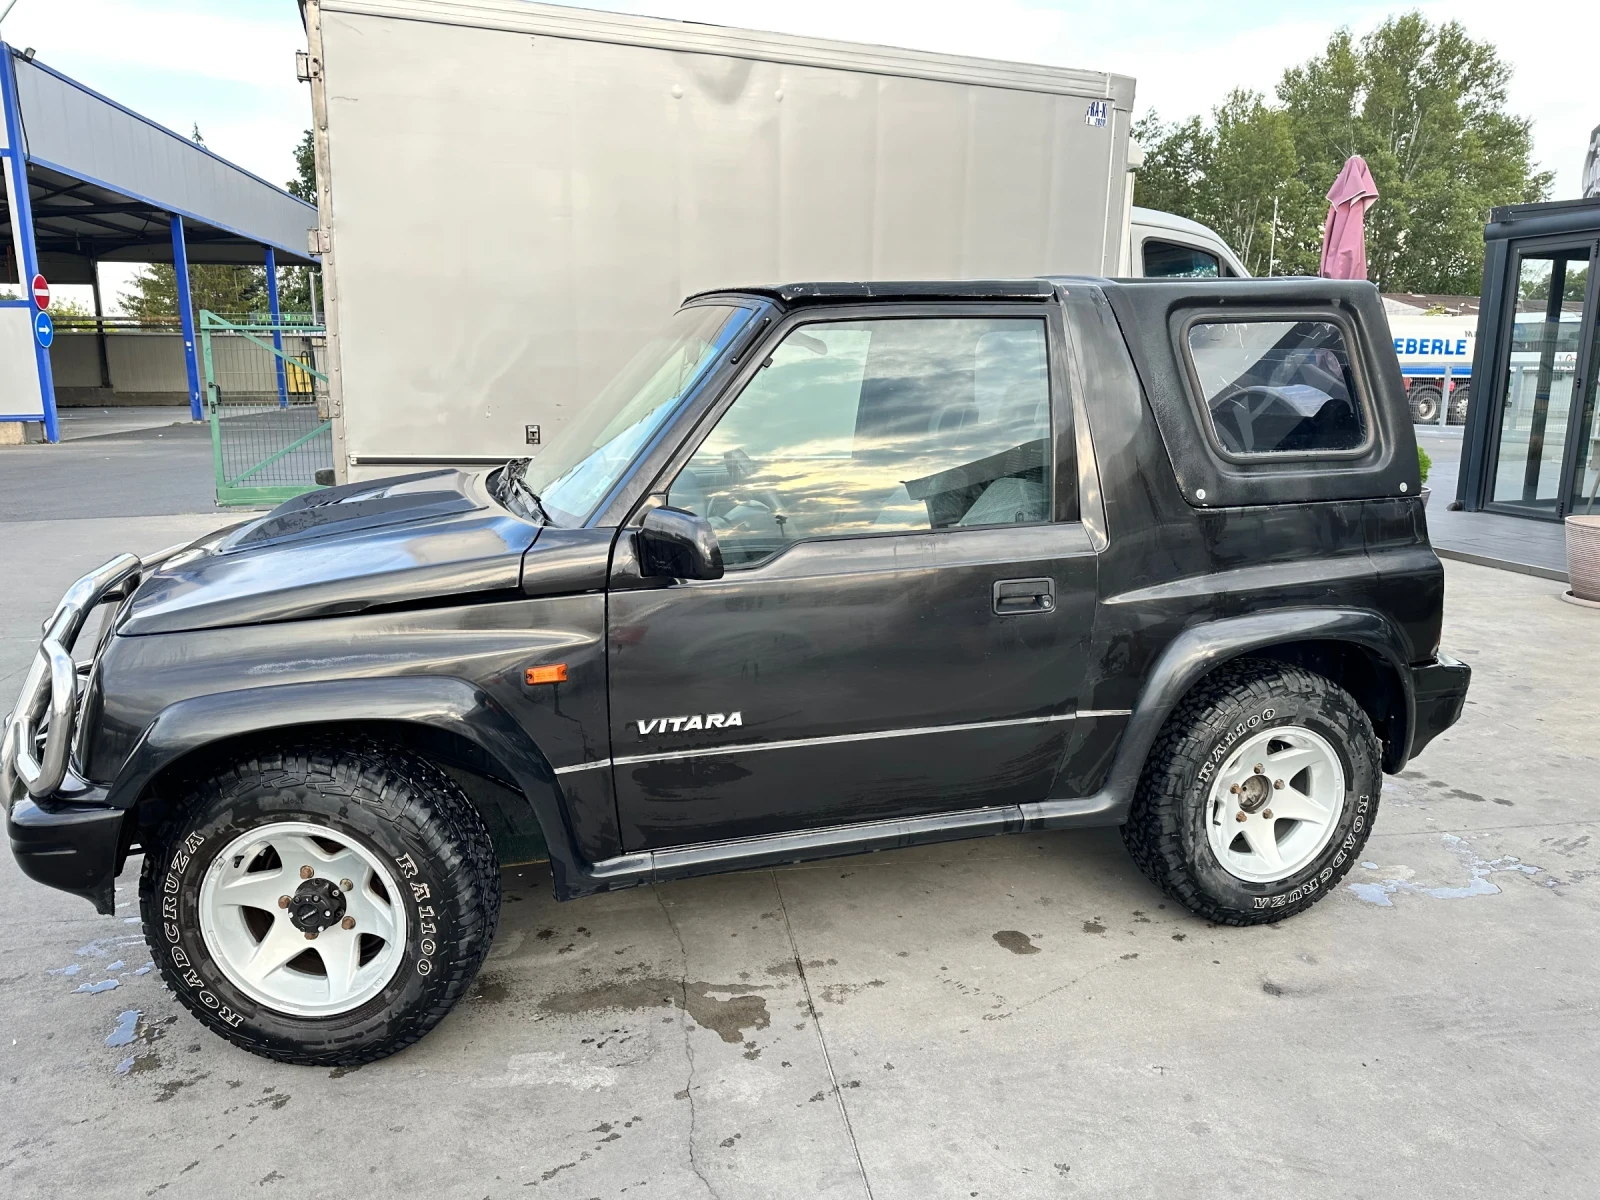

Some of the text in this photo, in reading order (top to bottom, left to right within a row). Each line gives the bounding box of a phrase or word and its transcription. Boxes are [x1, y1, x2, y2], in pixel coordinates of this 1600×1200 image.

[1393, 338, 1467, 356] EBERLE
[636, 711, 743, 735] VITARA
[1254, 795, 1369, 909] ROADCRUZA
[163, 831, 244, 1028] ROADCRUZA
[395, 852, 437, 976] RA1100
